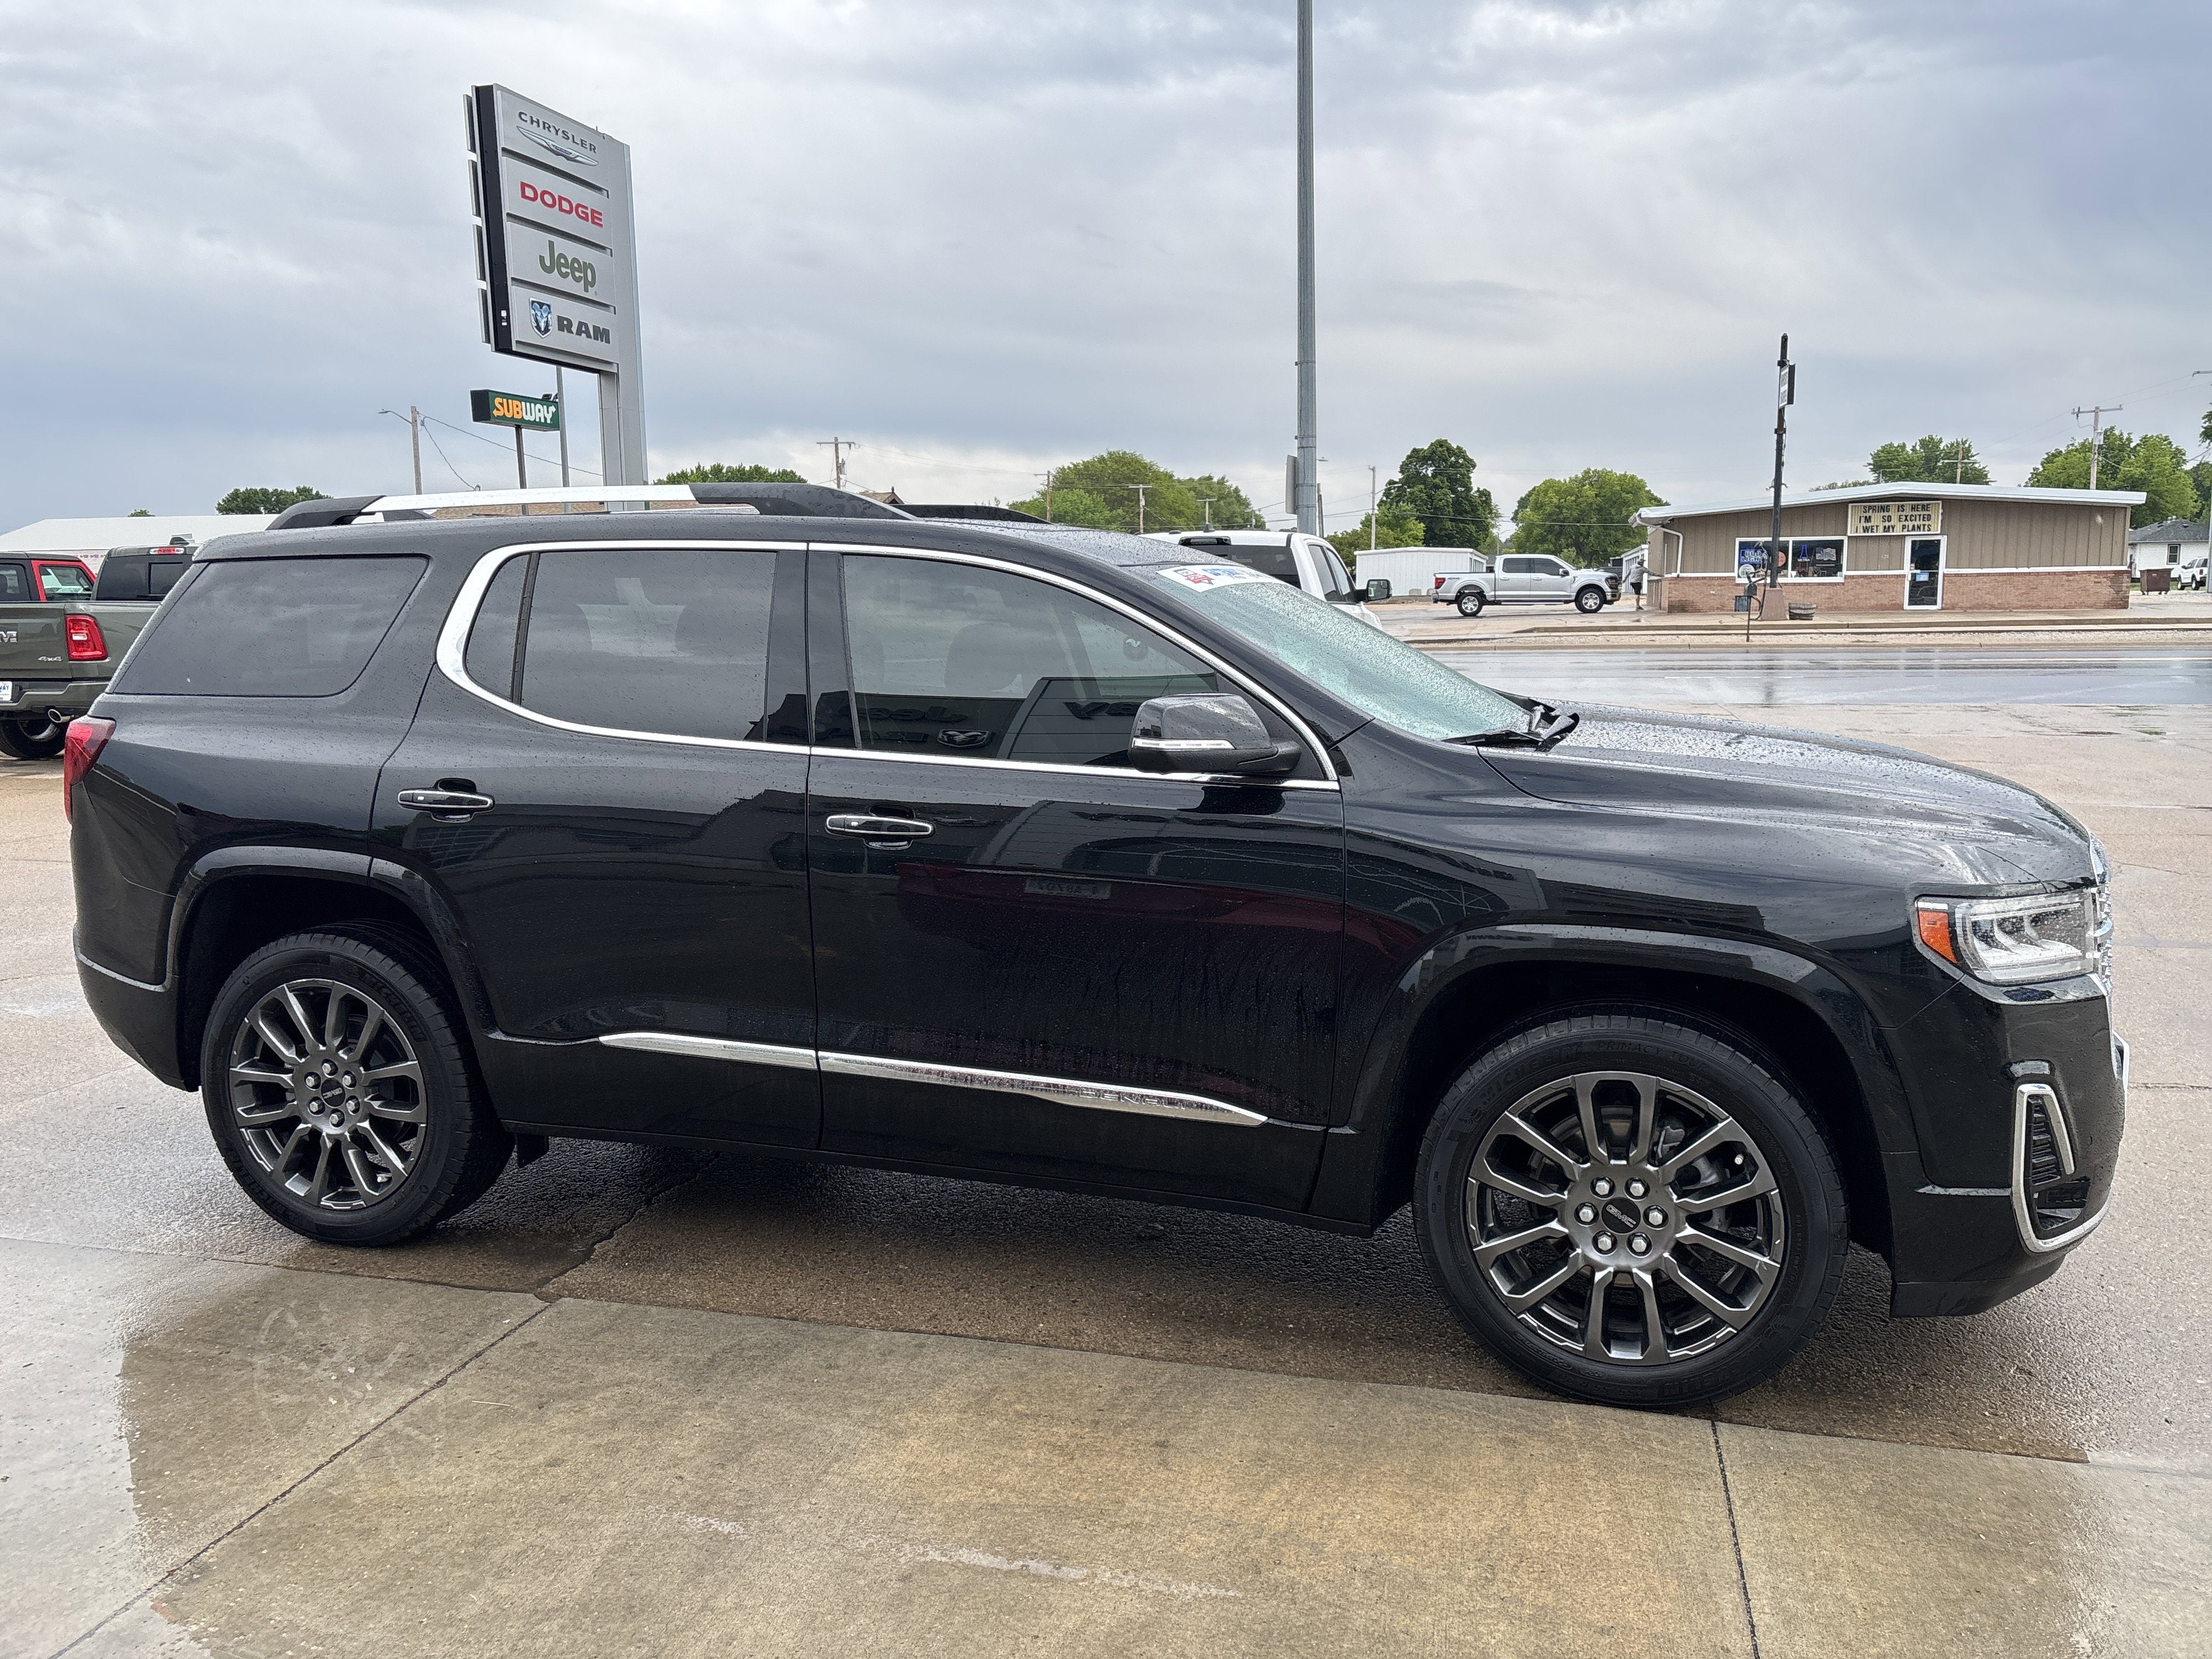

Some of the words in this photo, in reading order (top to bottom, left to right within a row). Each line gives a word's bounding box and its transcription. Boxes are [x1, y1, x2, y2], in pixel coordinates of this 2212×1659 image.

[518, 111, 597, 154] CHRYSLER
[520, 181, 603, 228] DODGE
[539, 240, 596, 292] Jeep
[557, 315, 611, 344] RAM
[493, 397, 556, 424] SUBWAY
[1863, 505, 1891, 514] SPRING
[1899, 514, 1931, 522] EXCITED
[1863, 525, 1879, 533] WET
[1883, 524, 1895, 533] MY
[1901, 524, 1931, 532] PLANTS
[1606, 1204, 1637, 1229] GMC
